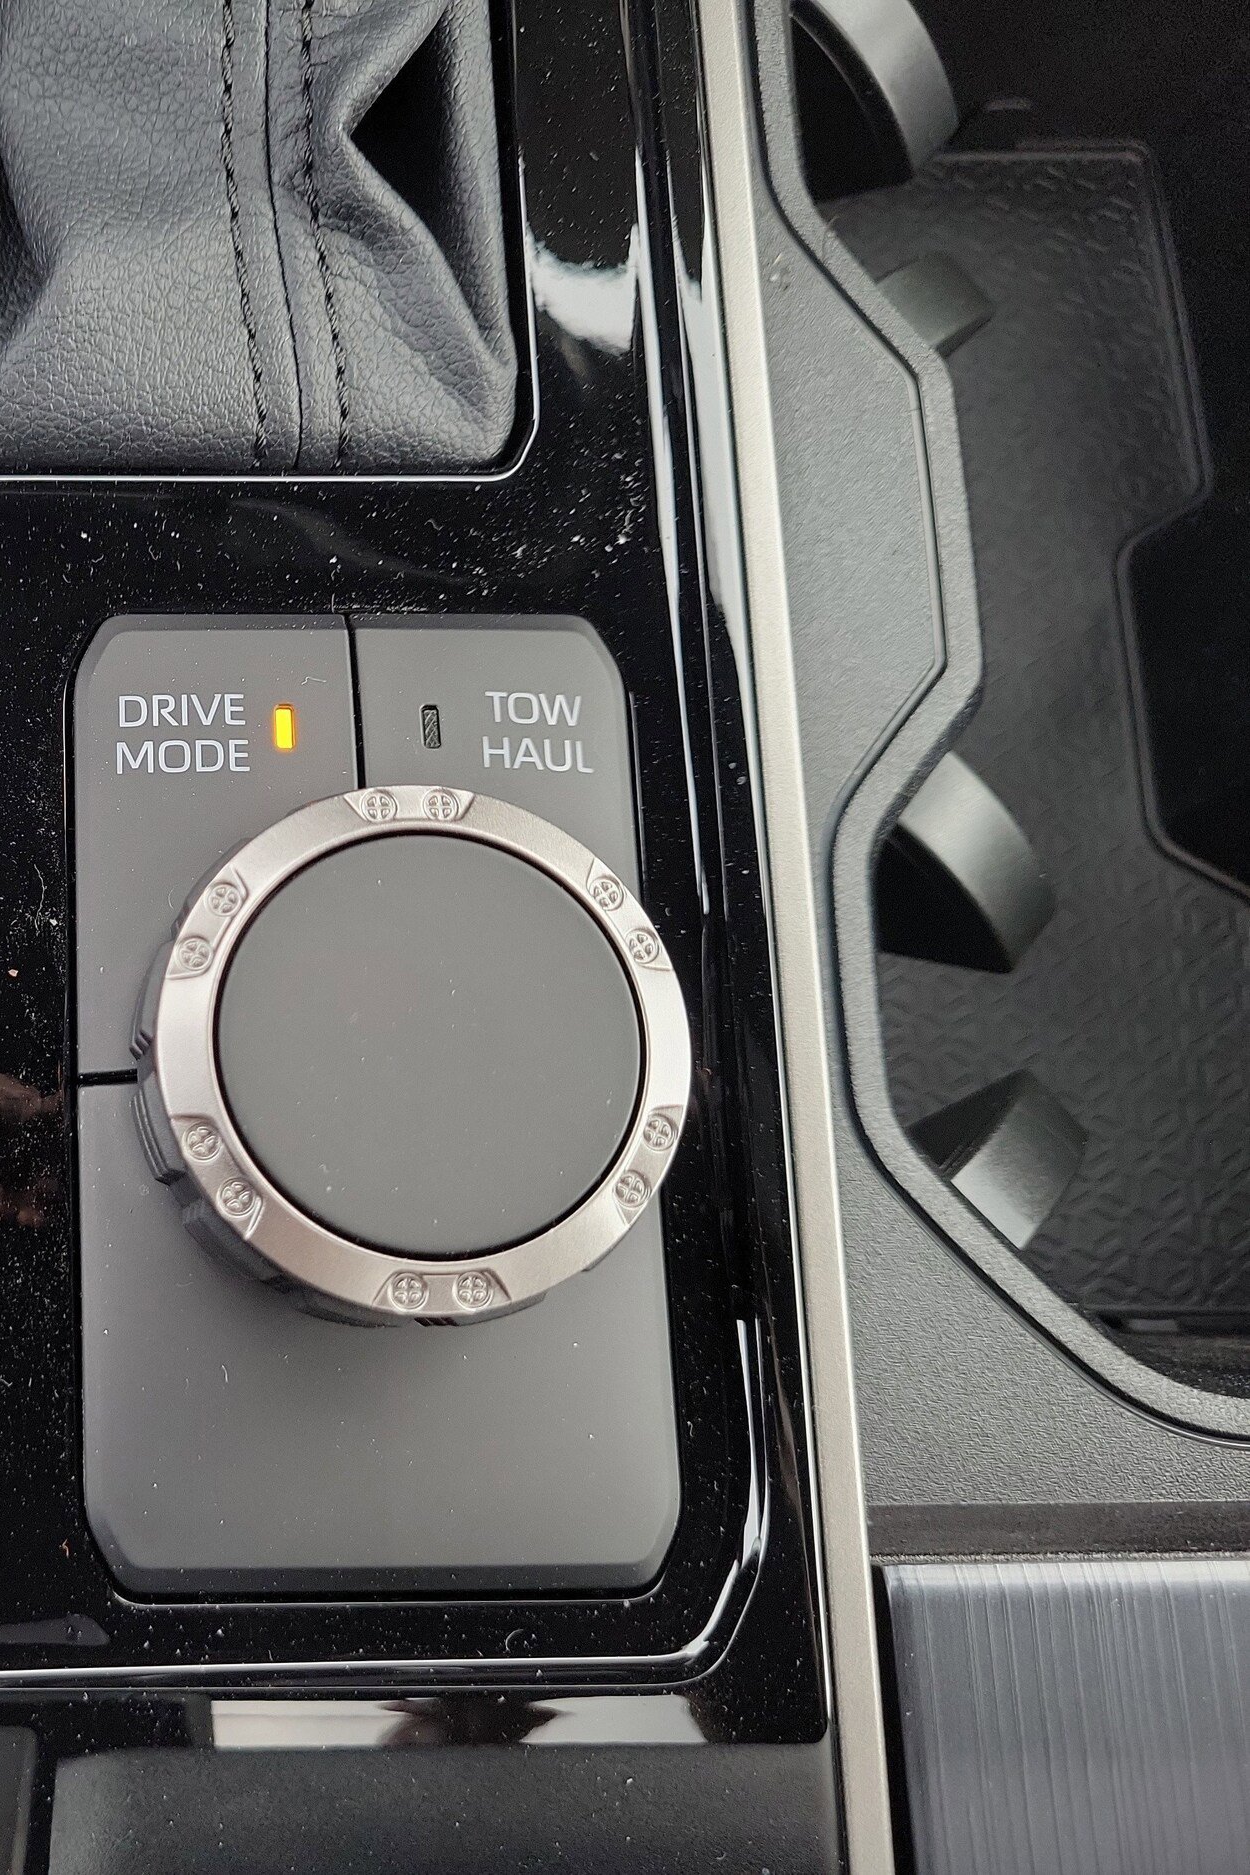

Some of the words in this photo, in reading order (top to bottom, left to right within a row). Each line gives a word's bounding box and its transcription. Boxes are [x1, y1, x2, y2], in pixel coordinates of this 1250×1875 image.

[118, 693, 246, 728] DRIVE
[484, 691, 582, 727] TOW
[116, 739, 251, 775] MODE
[482, 736, 594, 774] HAUL
